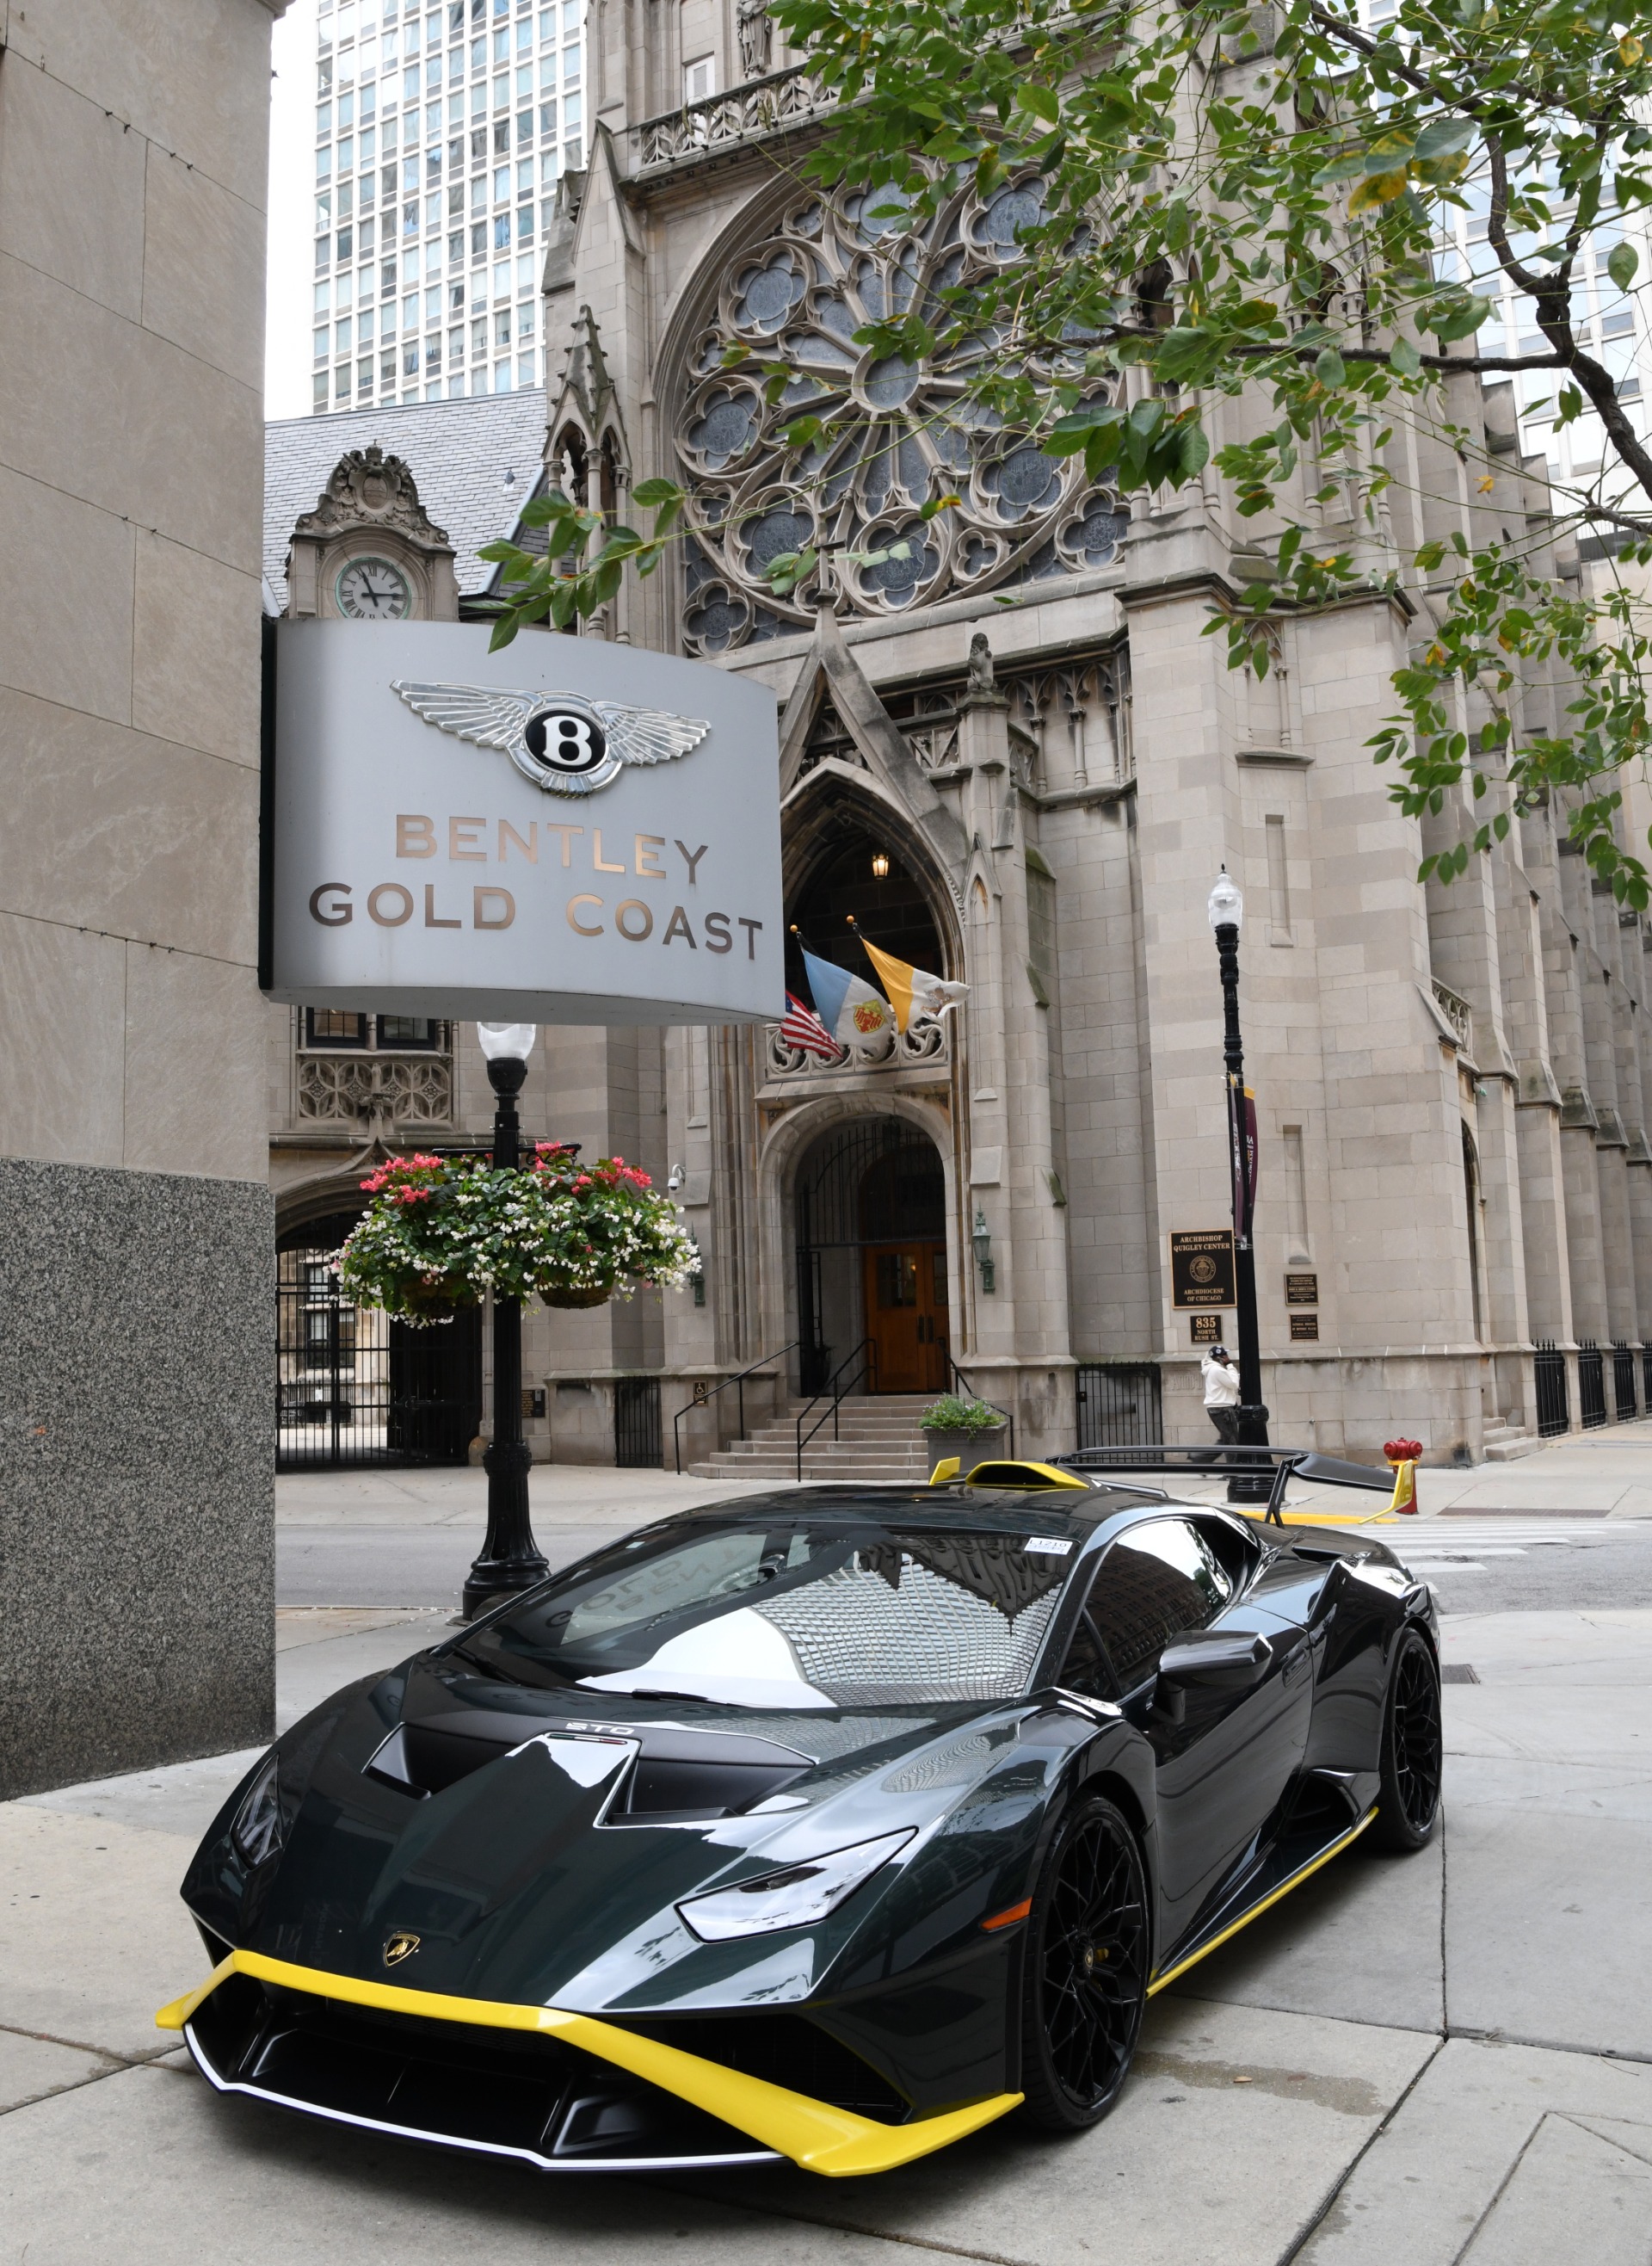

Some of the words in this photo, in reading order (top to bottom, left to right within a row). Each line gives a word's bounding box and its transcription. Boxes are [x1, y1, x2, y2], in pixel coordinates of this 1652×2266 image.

[542, 715, 593, 766] B
[396, 814, 709, 885] BENTLEY
[309, 882, 516, 930] GOLD
[566, 892, 763, 960] COAST
[1180, 1234, 1224, 1244] ARCHBISHOP
[1173, 1244, 1203, 1253] QUIGLEY
[1203, 1242, 1230, 1250] CENTER
[1195, 1317, 1217, 1329] 835
[565, 1722, 635, 1736] STO
